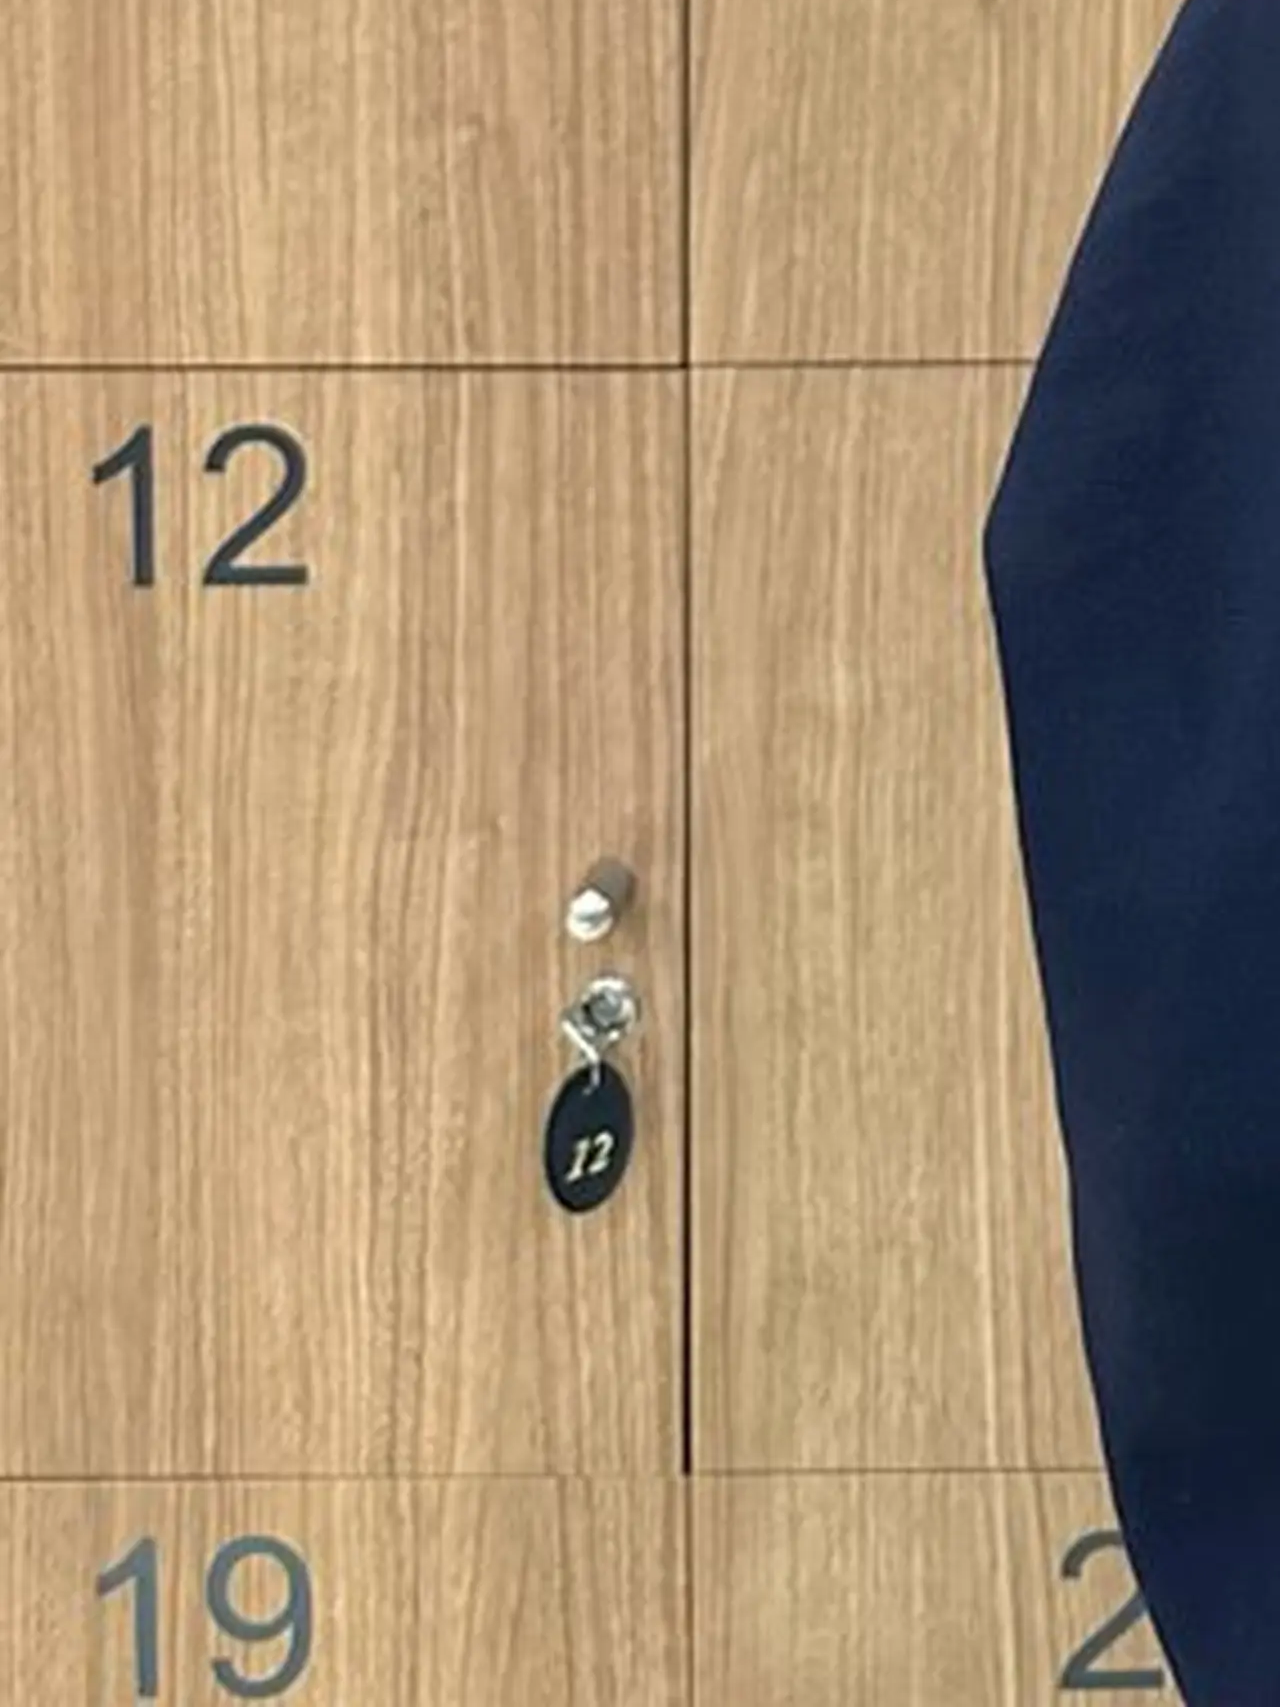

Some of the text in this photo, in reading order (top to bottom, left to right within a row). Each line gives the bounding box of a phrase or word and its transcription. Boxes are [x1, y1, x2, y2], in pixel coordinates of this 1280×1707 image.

[92, 423, 309, 588] 12
[565, 1130, 615, 1182] 12
[93, 1535, 314, 1699] 19
[1056, 1529, 1169, 1692] 2
